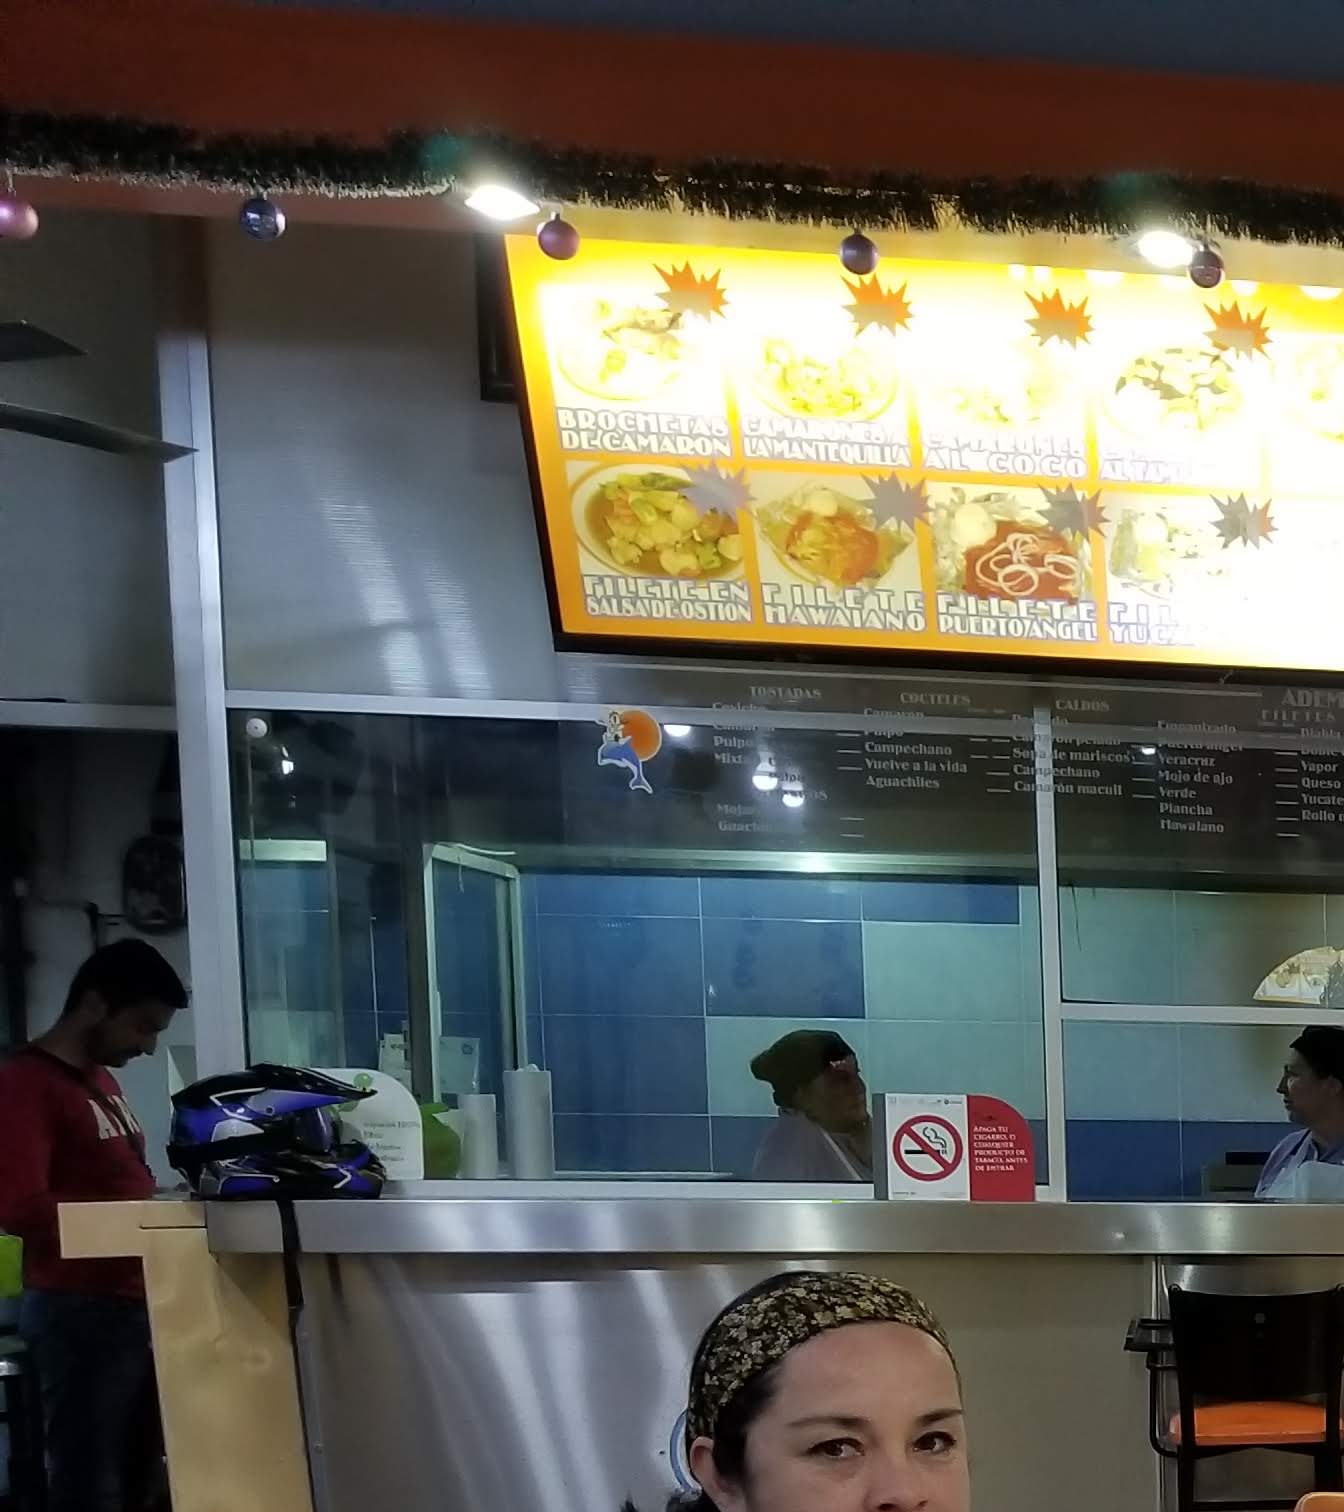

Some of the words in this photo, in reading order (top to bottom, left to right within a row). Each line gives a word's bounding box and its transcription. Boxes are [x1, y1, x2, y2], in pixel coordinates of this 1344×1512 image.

[558, 406, 731, 436] BROCHETAS
[562, 429, 602, 449] DE
[602, 430, 732, 457] CAMARON
[776, 437, 912, 468] MANTEQUILLA
[986, 451, 1088, 478] COCO
[761, 584, 924, 613] FILETE
[587, 595, 651, 617] SALSA
[682, 601, 752, 623] OSTION
[762, 605, 926, 632] HAWAIANO
[938, 614, 1029, 639] PUERTO
[749, 686, 822, 700] TOSTADAS
[865, 742, 953, 758] Campechano
[1069, 750, 1131, 764] mariscos
[866, 758, 911, 771] Vuelve
[913, 761, 922, 771] a
[924, 760, 938, 772] la
[940, 761, 969, 774] vida
[1159, 754, 1217, 768] Veracruz
[1301, 761, 1339, 776] Vapor
[867, 775, 941, 790] Aguachiles
[1159, 769, 1192, 784] Mojo
[1194, 771, 1211, 783] de
[1213, 772, 1235, 786] ajo
[1301, 777, 1342, 790] Queso
[1159, 785, 1198, 799] Verde
[1159, 802, 1214, 816] Plancha
[1301, 810, 1336, 822] Rollo
[1160, 819, 1226, 834] Hawaiano
